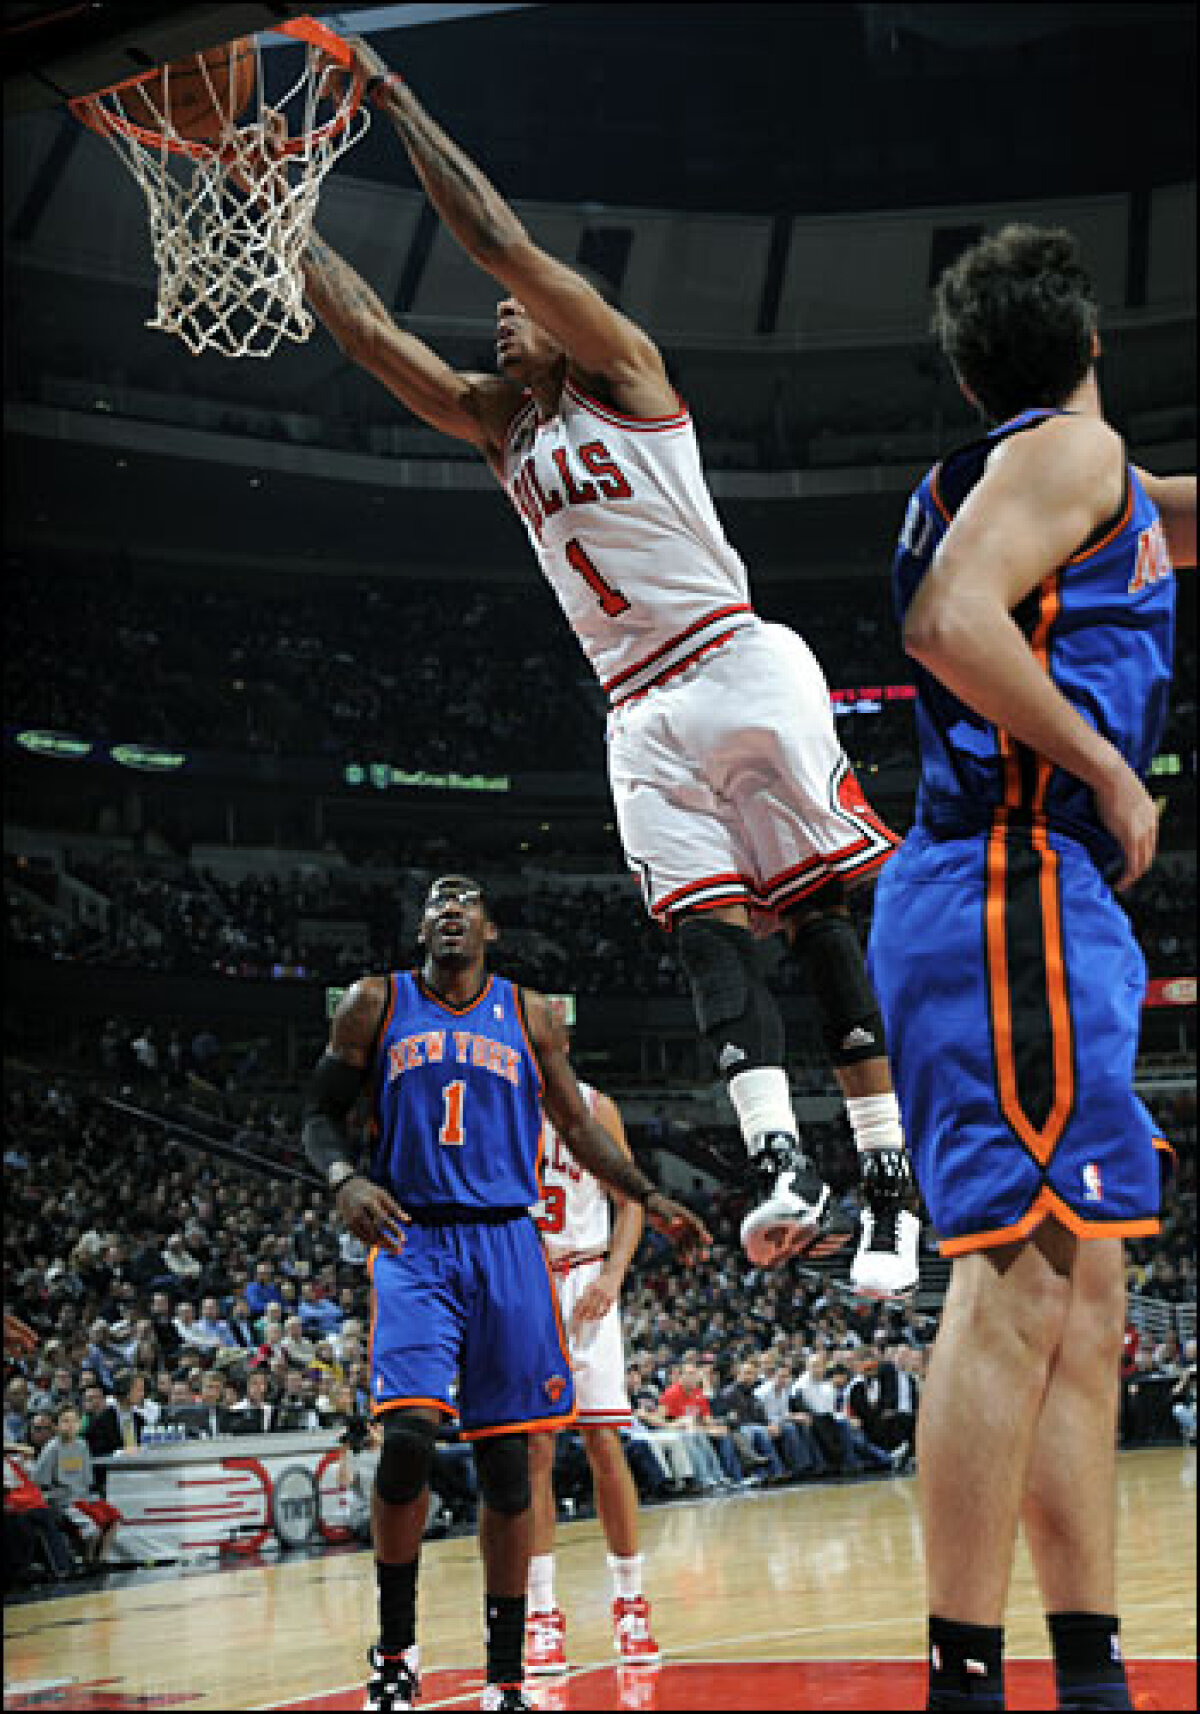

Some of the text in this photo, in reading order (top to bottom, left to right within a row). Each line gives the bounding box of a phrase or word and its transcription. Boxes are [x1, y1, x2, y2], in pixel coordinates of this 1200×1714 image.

[565, 537, 632, 617] 1
[388, 1029, 521, 1087] NEW YORK
[439, 1080, 466, 1145] 1
